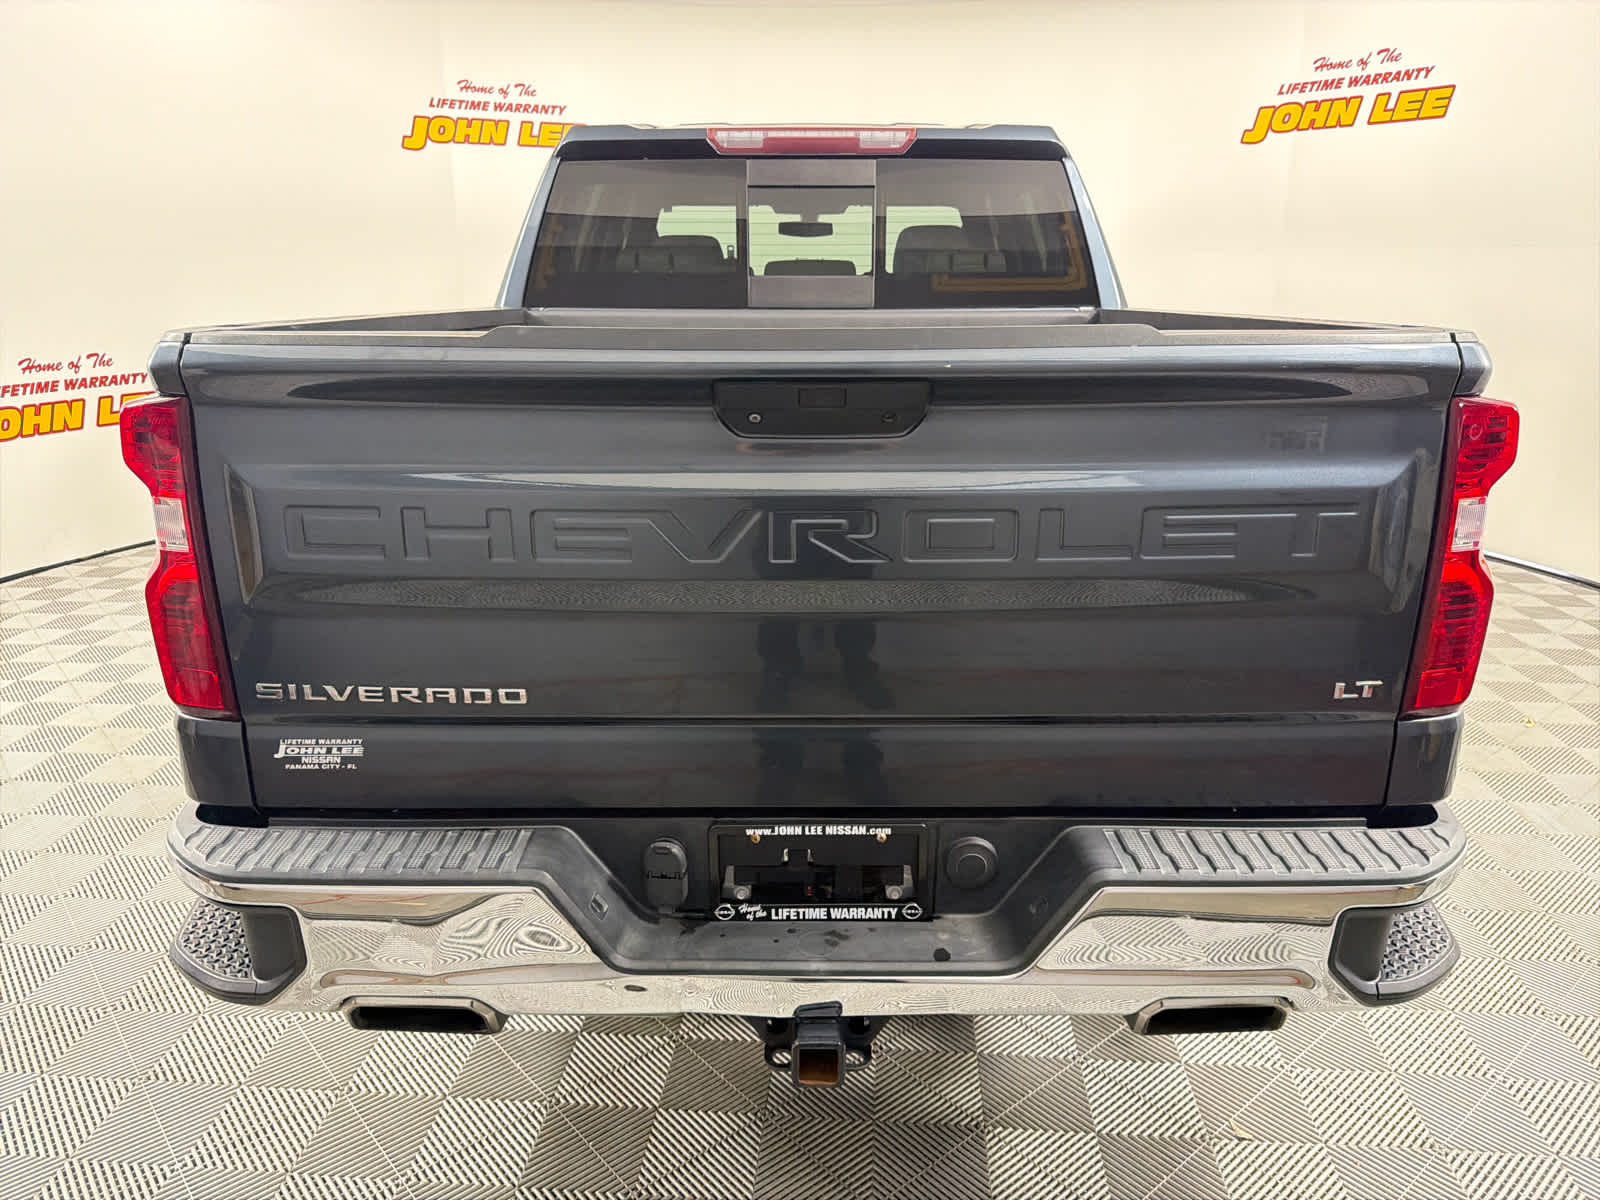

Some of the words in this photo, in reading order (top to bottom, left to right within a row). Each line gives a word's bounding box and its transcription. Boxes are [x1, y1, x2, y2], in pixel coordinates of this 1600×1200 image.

[1313, 56, 1352, 72] Home
[1356, 52, 1372, 71] of
[1376, 48, 1402, 65] The
[457, 79, 495, 94] Home
[498, 84, 510, 99] of
[514, 83, 537, 97] The
[1277, 77, 1345, 96] LIFETIME
[1347, 65, 1436, 88] WARRANTY
[429, 97, 490, 111] LIFETIME
[493, 100, 567, 116] WARRANTY
[1240, 95, 1363, 144] JOHN
[1367, 84, 1456, 125] LEE
[401, 115, 510, 151] JOHN
[517, 120, 587, 148] LE
[18, 357, 63, 375] Home
[67, 355, 82, 374] of
[86, 352, 114, 369] The
[0, 379, 59, 398] FETIME
[64, 372, 148, 391] WARRANTY
[283, 504, 1358, 564] CHEVROLET
[255, 682, 528, 705] SILVERADO
[1333, 680, 1383, 699] LT
[273, 744, 327, 759] JOHN
[331, 746, 364, 755] LEE
[301, 756, 341, 764] NISSAN
[804, 825, 823, 836] LEE
[825, 825, 892, 836] NISSAN.com
[771, 907, 828, 920] LIFETIME
[830, 907, 898, 920] WARRANTY
